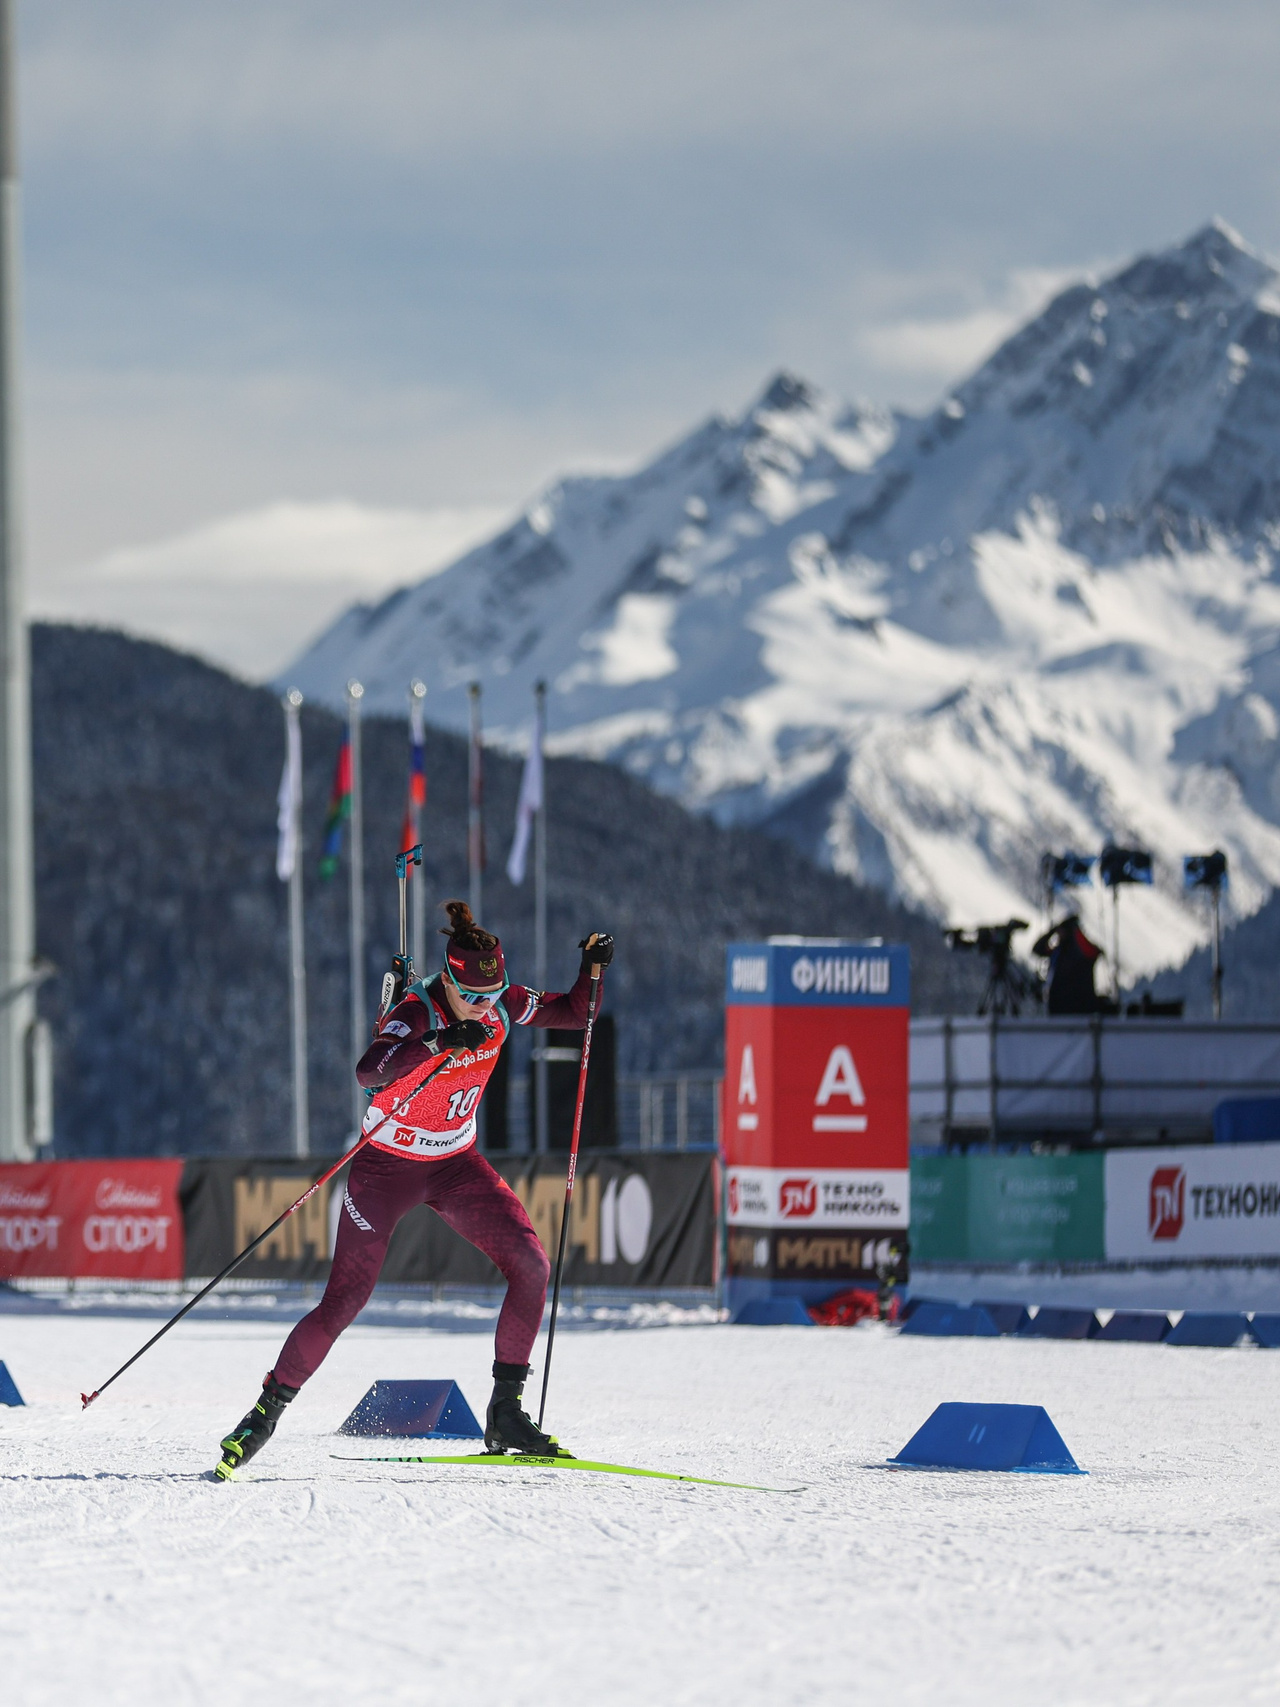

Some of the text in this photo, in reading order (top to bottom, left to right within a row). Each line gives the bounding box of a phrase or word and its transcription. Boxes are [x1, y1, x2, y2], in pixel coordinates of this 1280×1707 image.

[791, 955, 891, 994] ФИНИШ
[446, 1046, 500, 1069] льфа Банк
[582, 1018, 593, 1071] MOAX
[446, 1085, 480, 1121] 10
[289, 1183, 320, 1213] MOAX
[513, 1456, 555, 1464] FISCHER
